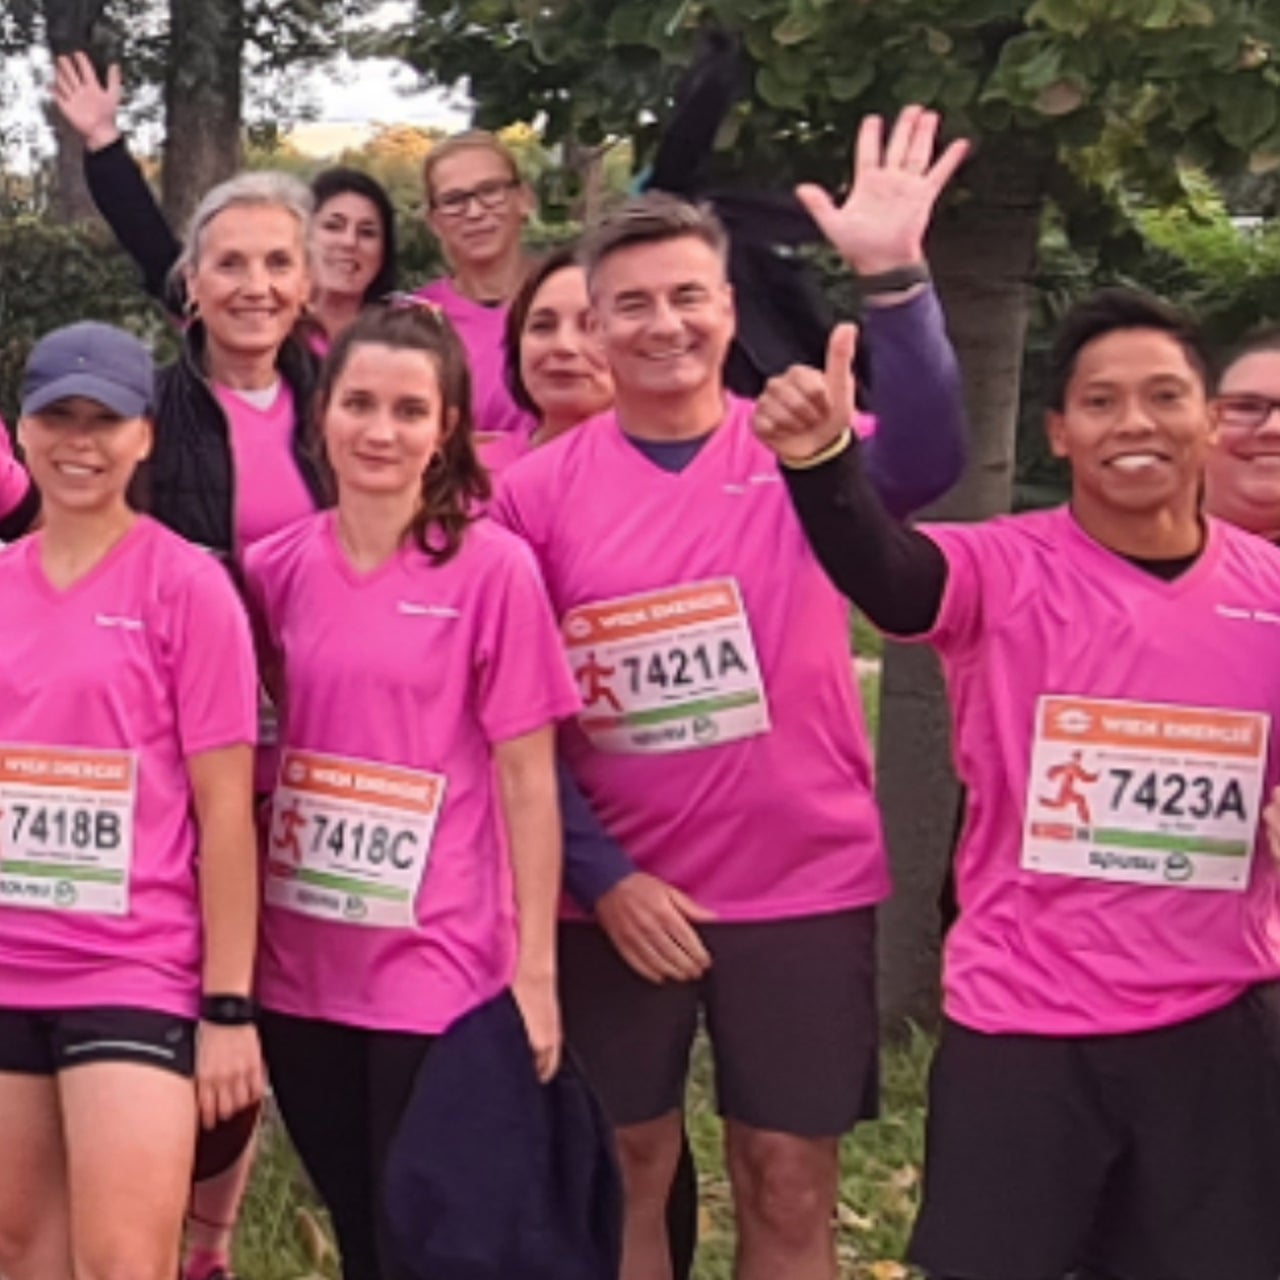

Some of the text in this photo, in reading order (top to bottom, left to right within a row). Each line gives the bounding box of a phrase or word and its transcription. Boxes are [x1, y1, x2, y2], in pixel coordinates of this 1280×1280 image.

[621, 638, 749, 695] 7421A
[1109, 769, 1247, 822] 7423A
[11, 804, 121, 850] 7418B
[310, 814, 418, 870] 7418C
